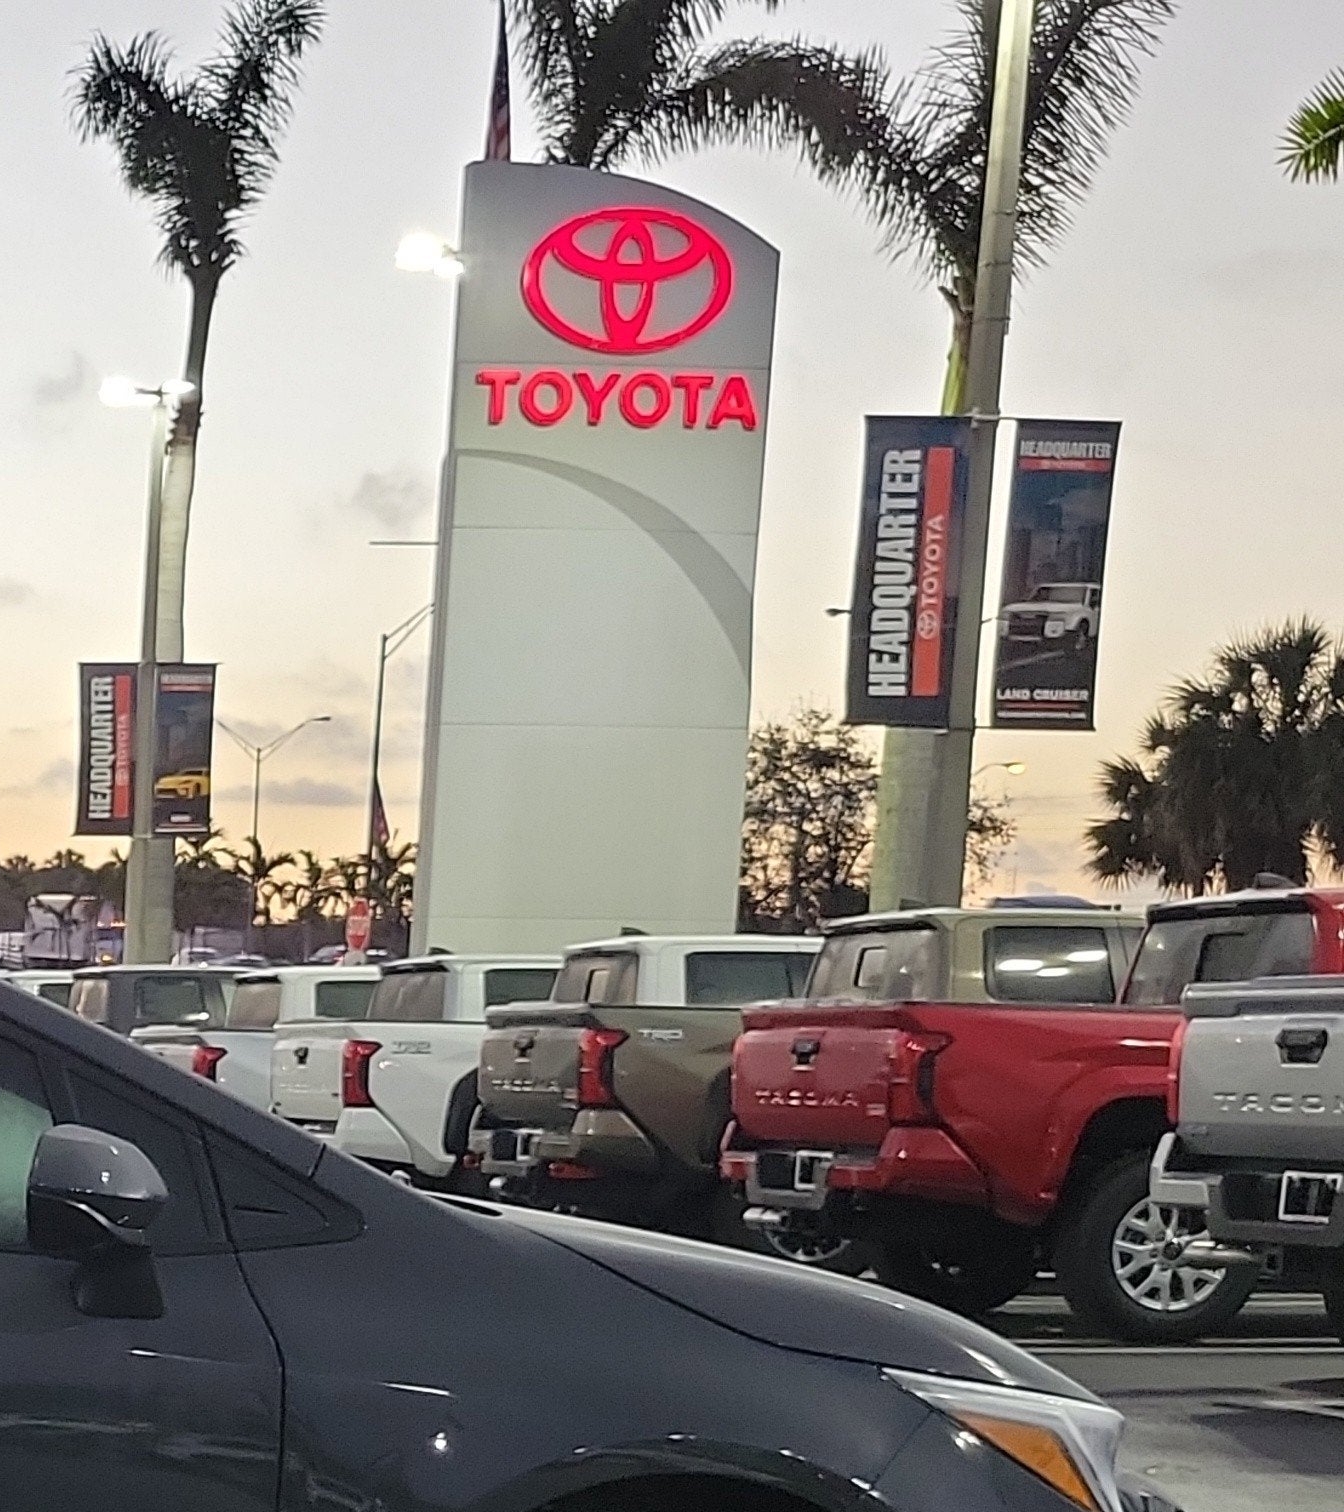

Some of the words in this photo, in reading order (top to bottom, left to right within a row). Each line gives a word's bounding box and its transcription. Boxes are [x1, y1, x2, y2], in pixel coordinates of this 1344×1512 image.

[477, 370, 757, 430] TOYOTA
[1020, 441, 1111, 459] HEADQUARTER
[868, 449, 921, 696] HEADQUARTER
[921, 515, 944, 605] TOYOTA
[996, 689, 1031, 700] LAND
[88, 676, 115, 819] HEADQUARTER
[755, 1089, 859, 1107] TACOMA
